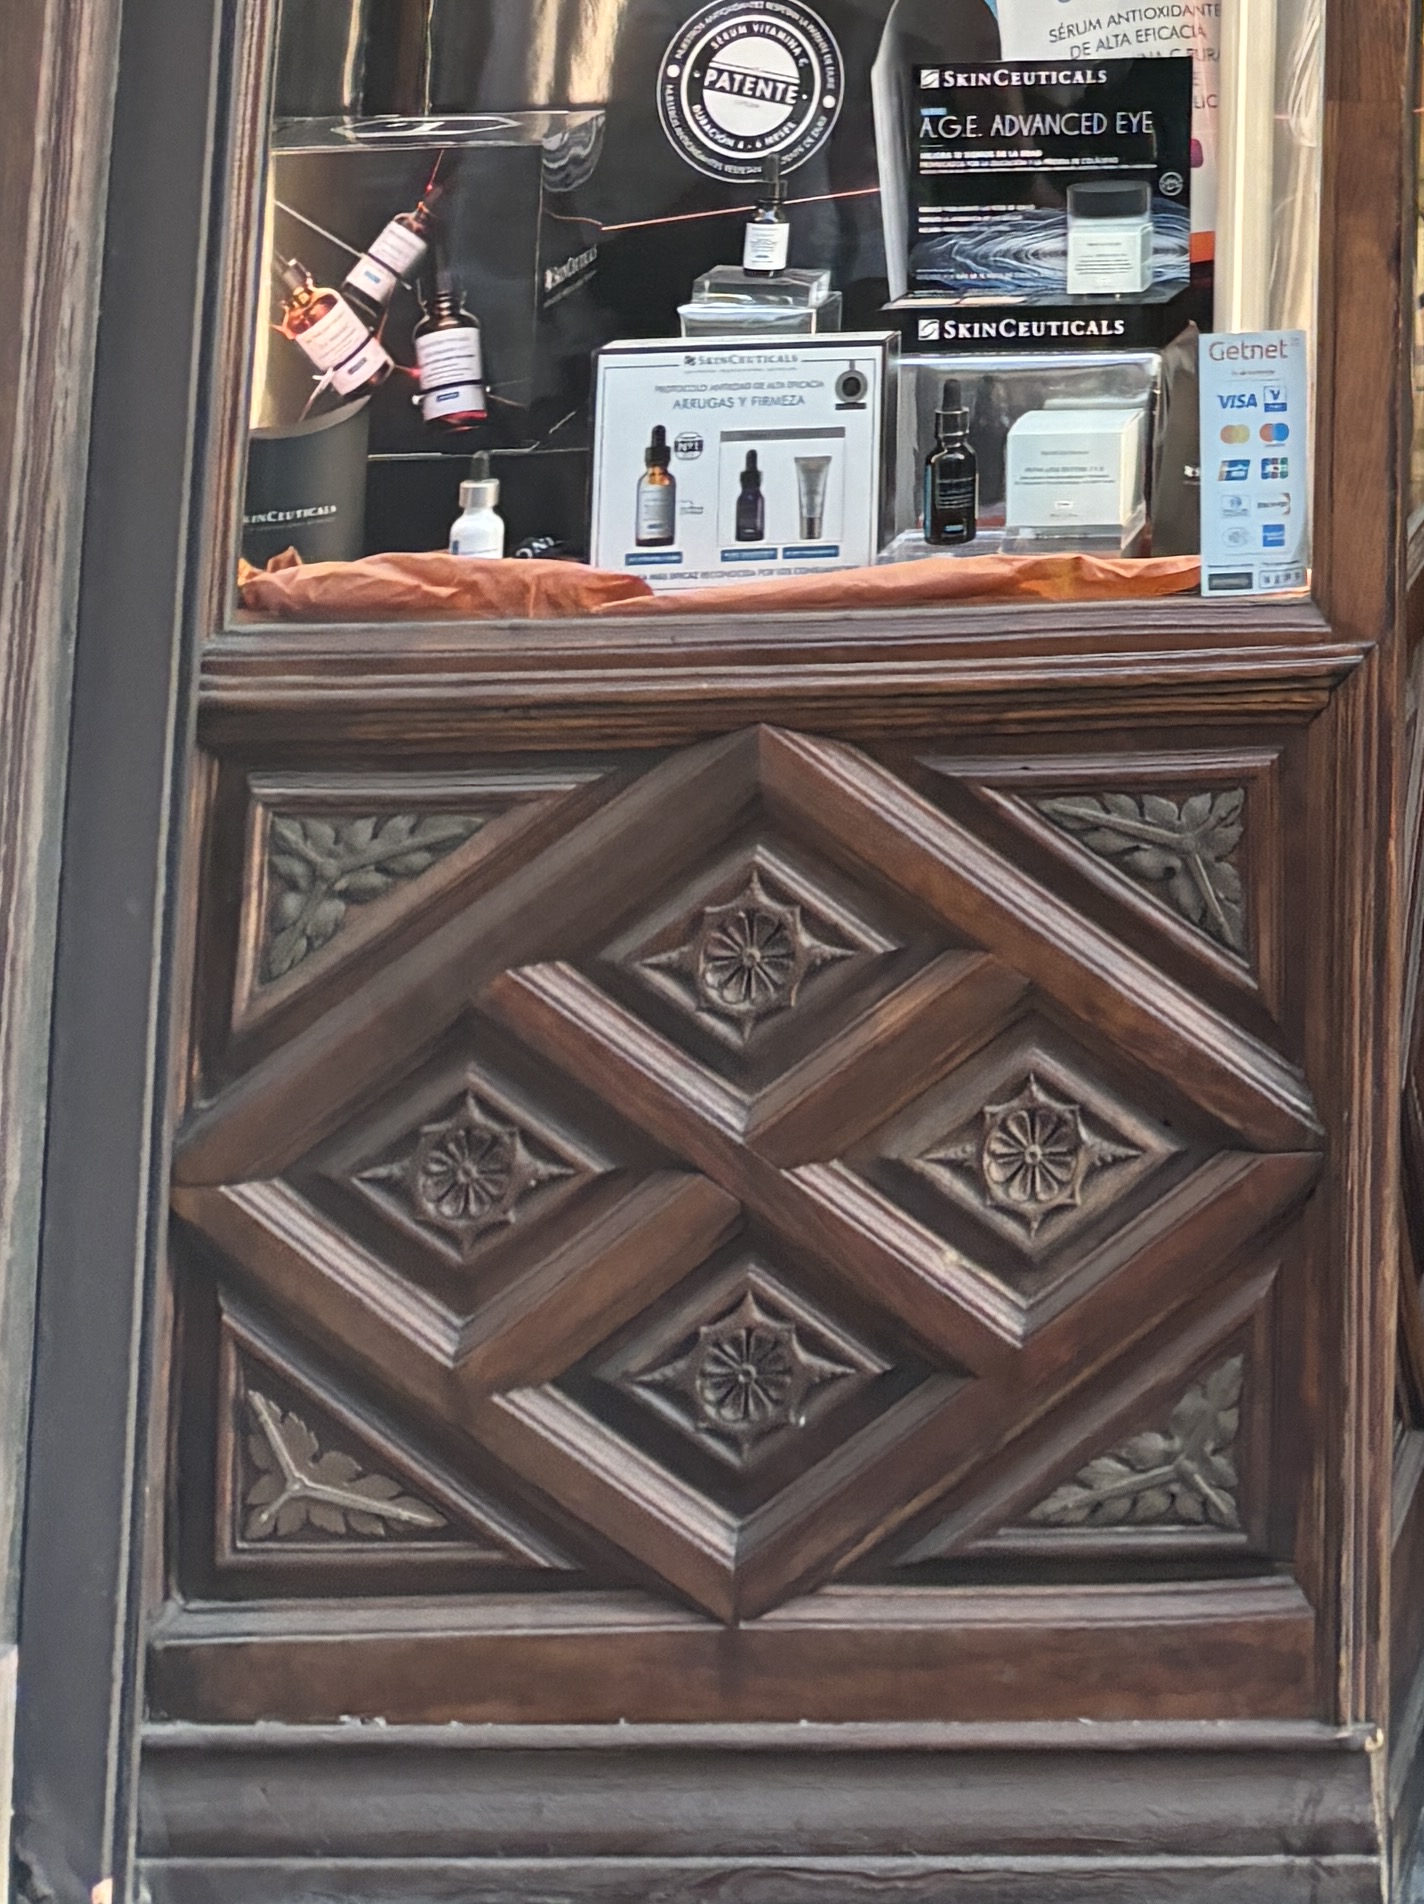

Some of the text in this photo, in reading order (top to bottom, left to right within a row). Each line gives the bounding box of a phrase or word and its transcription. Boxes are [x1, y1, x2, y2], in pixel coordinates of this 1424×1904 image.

[1048, 2, 1222, 44] SÉRUM ANTIOXIDANTE
[1069, 24, 1209, 61] DE ALTA EFICACIA
[703, 68, 800, 105] PATENTE
[990, 112, 1107, 138] ADVANCED
[1115, 111, 1154, 135] EYE
[1208, 338, 1289, 363] Getnet
[1217, 392, 1259, 410] VISA
